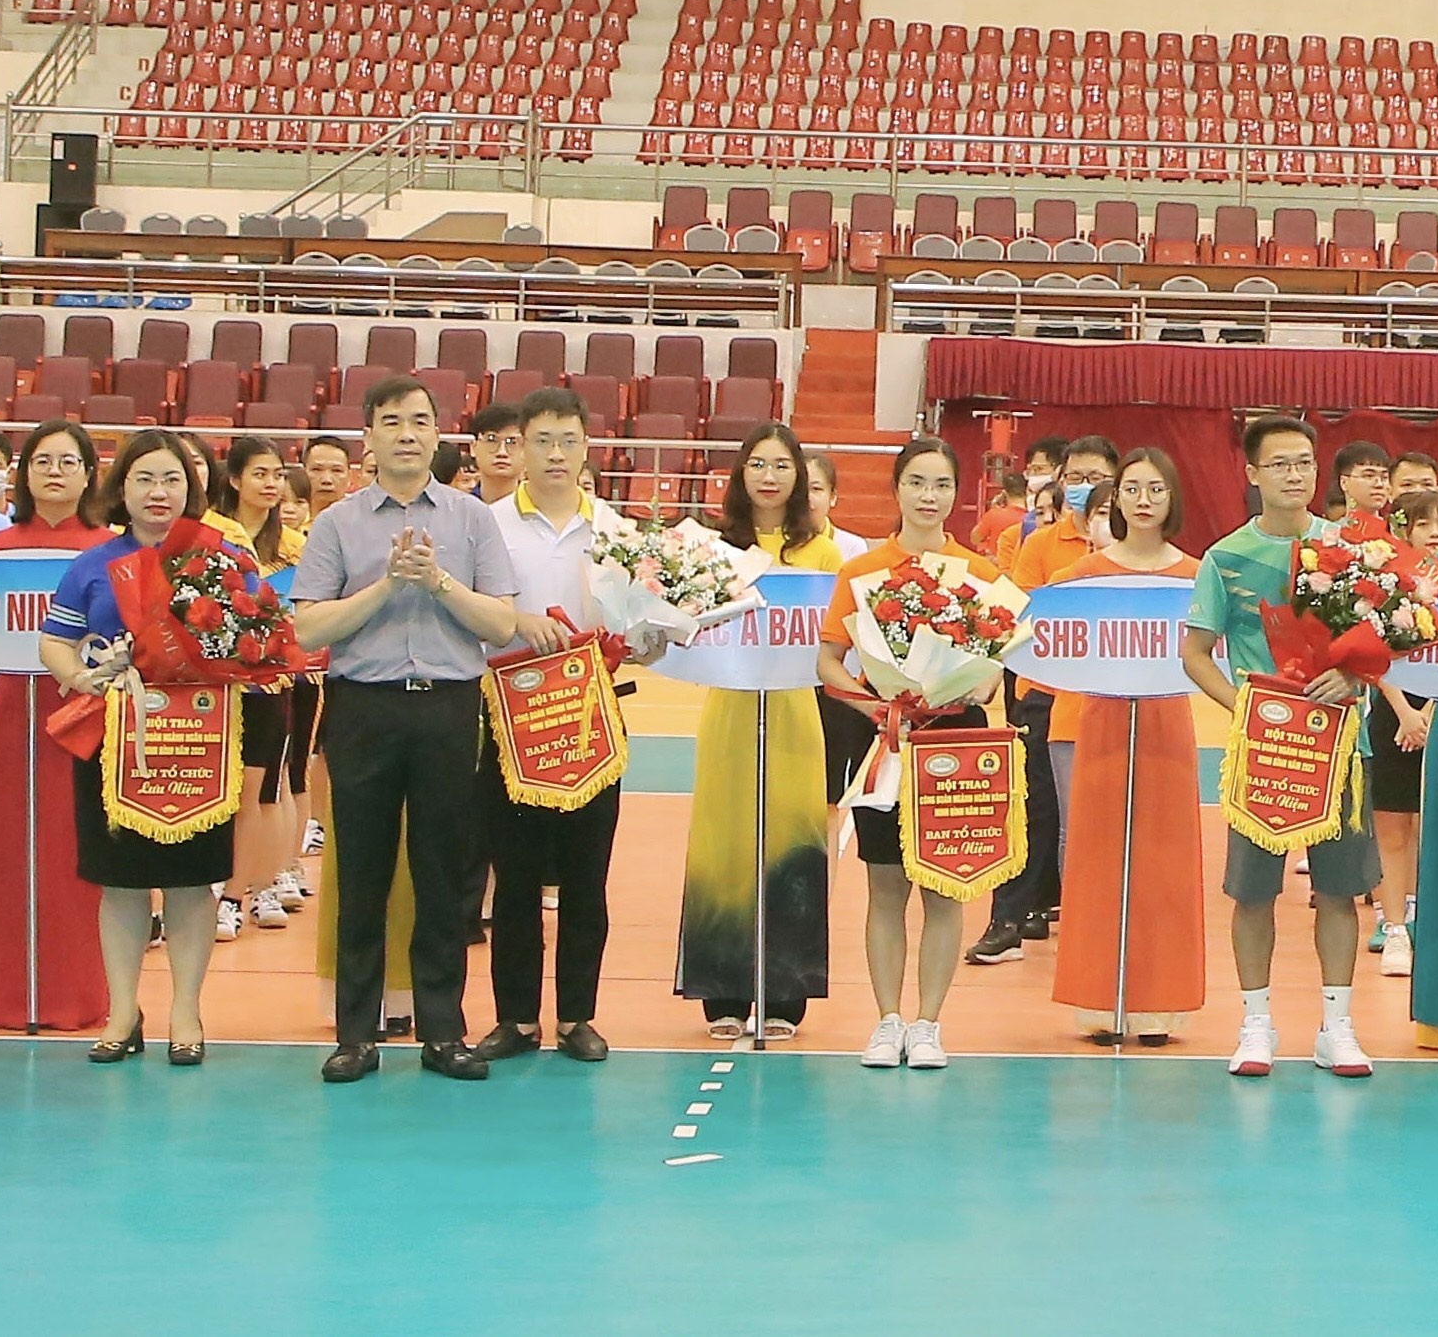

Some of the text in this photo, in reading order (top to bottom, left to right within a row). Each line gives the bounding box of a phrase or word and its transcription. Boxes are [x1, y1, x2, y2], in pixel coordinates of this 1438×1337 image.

[1034, 620, 1088, 658] SHB
[1099, 621, 1167, 658] NINH
[170, 719, 203, 728] THAO
[1265, 728, 1316, 746] HỘI THAO
[131, 764, 213, 778] BN TỔ CHỨC
[936, 779, 990, 792] HỘI THAO
[1272, 777, 1288, 791] TỔ
[1289, 783, 1320, 796] CHỨC
[926, 824, 1003, 840] BAN TỔ CHỨC
